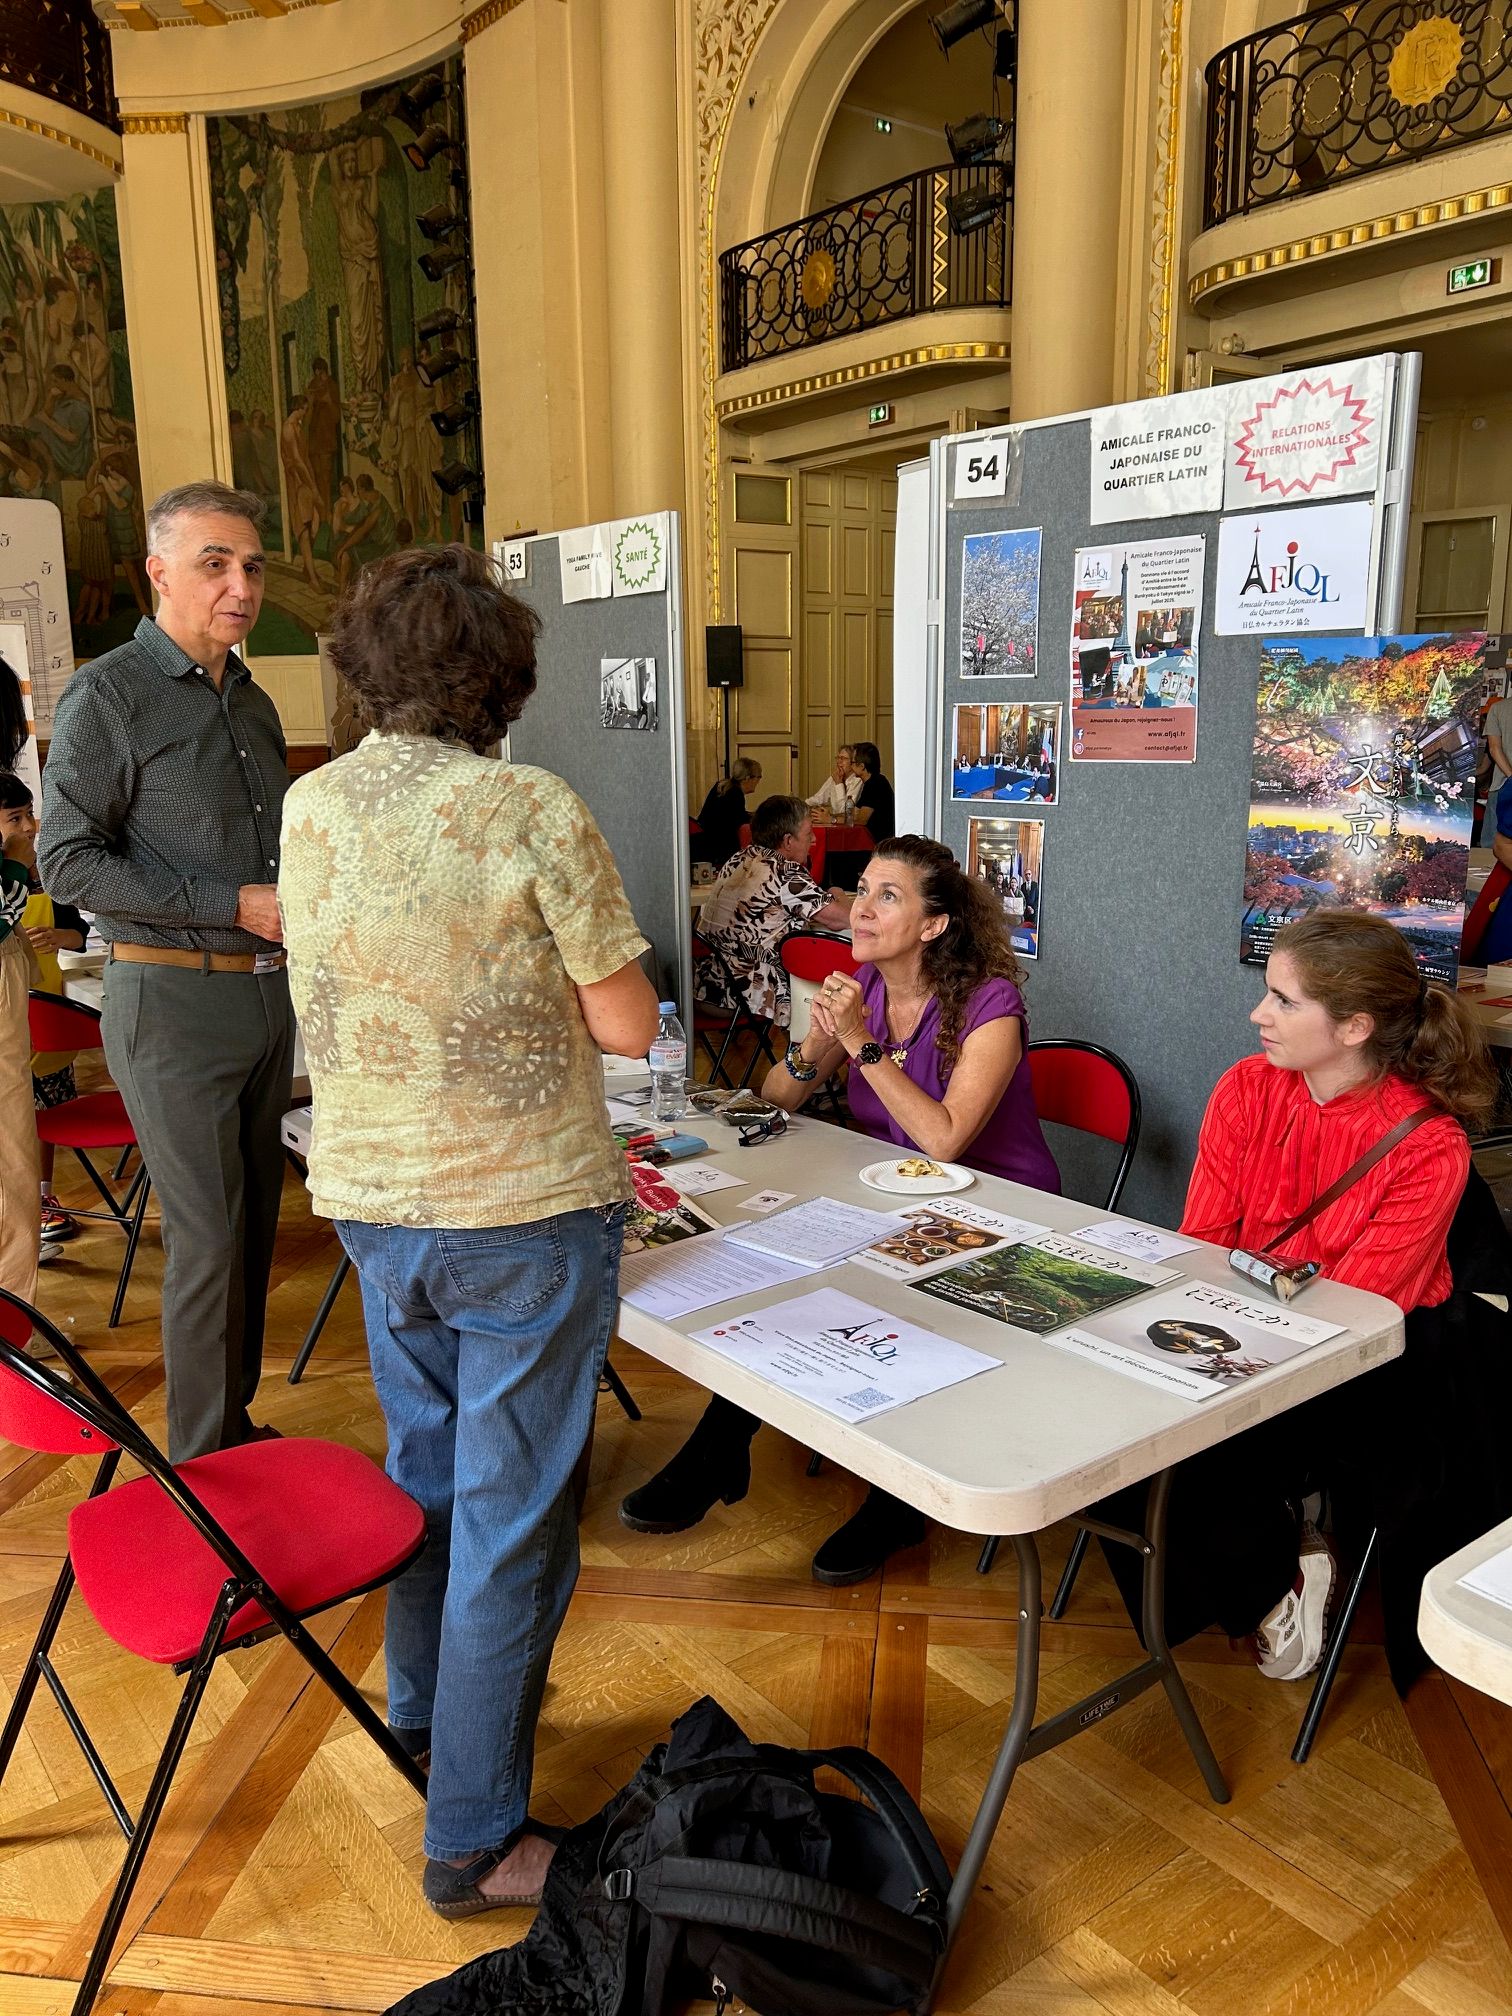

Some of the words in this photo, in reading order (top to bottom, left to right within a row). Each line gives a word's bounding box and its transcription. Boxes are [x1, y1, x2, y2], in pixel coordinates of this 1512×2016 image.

[1100, 434, 1154, 452] AMICALE
[1157, 422, 1216, 440] FRANCO-
[1271, 421, 1331, 439] RELATIONS
[1252, 433, 1351, 459] INTERNATIONALES
[1109, 447, 1179, 470] JAPONAISE
[1183, 445, 1202, 458] DU
[967, 455, 999, 483] 54
[1104, 472, 1165, 491] QUARTIER
[1169, 465, 1208, 480] LATIN
[576, 554, 590, 562] FAMILY
[625, 547, 648, 562] SANTÉ
[1154, 547, 1202, 557] Franco-Japonaise
[510, 553, 522, 570] 53
[575, 564, 590, 572] GAUCHE
[1238, 600, 1262, 608] Amicale
[1264, 598, 1317, 607] Franco-Japonaise
[1268, 915, 1292, 925] 文京区
[645, 1189, 668, 1208] Bunkyo
[1186, 1289, 1289, 1326] にぽにか
[1161, 1372, 1199, 1390] japonais
[1084, 1697, 1115, 1720] LIFETIME
